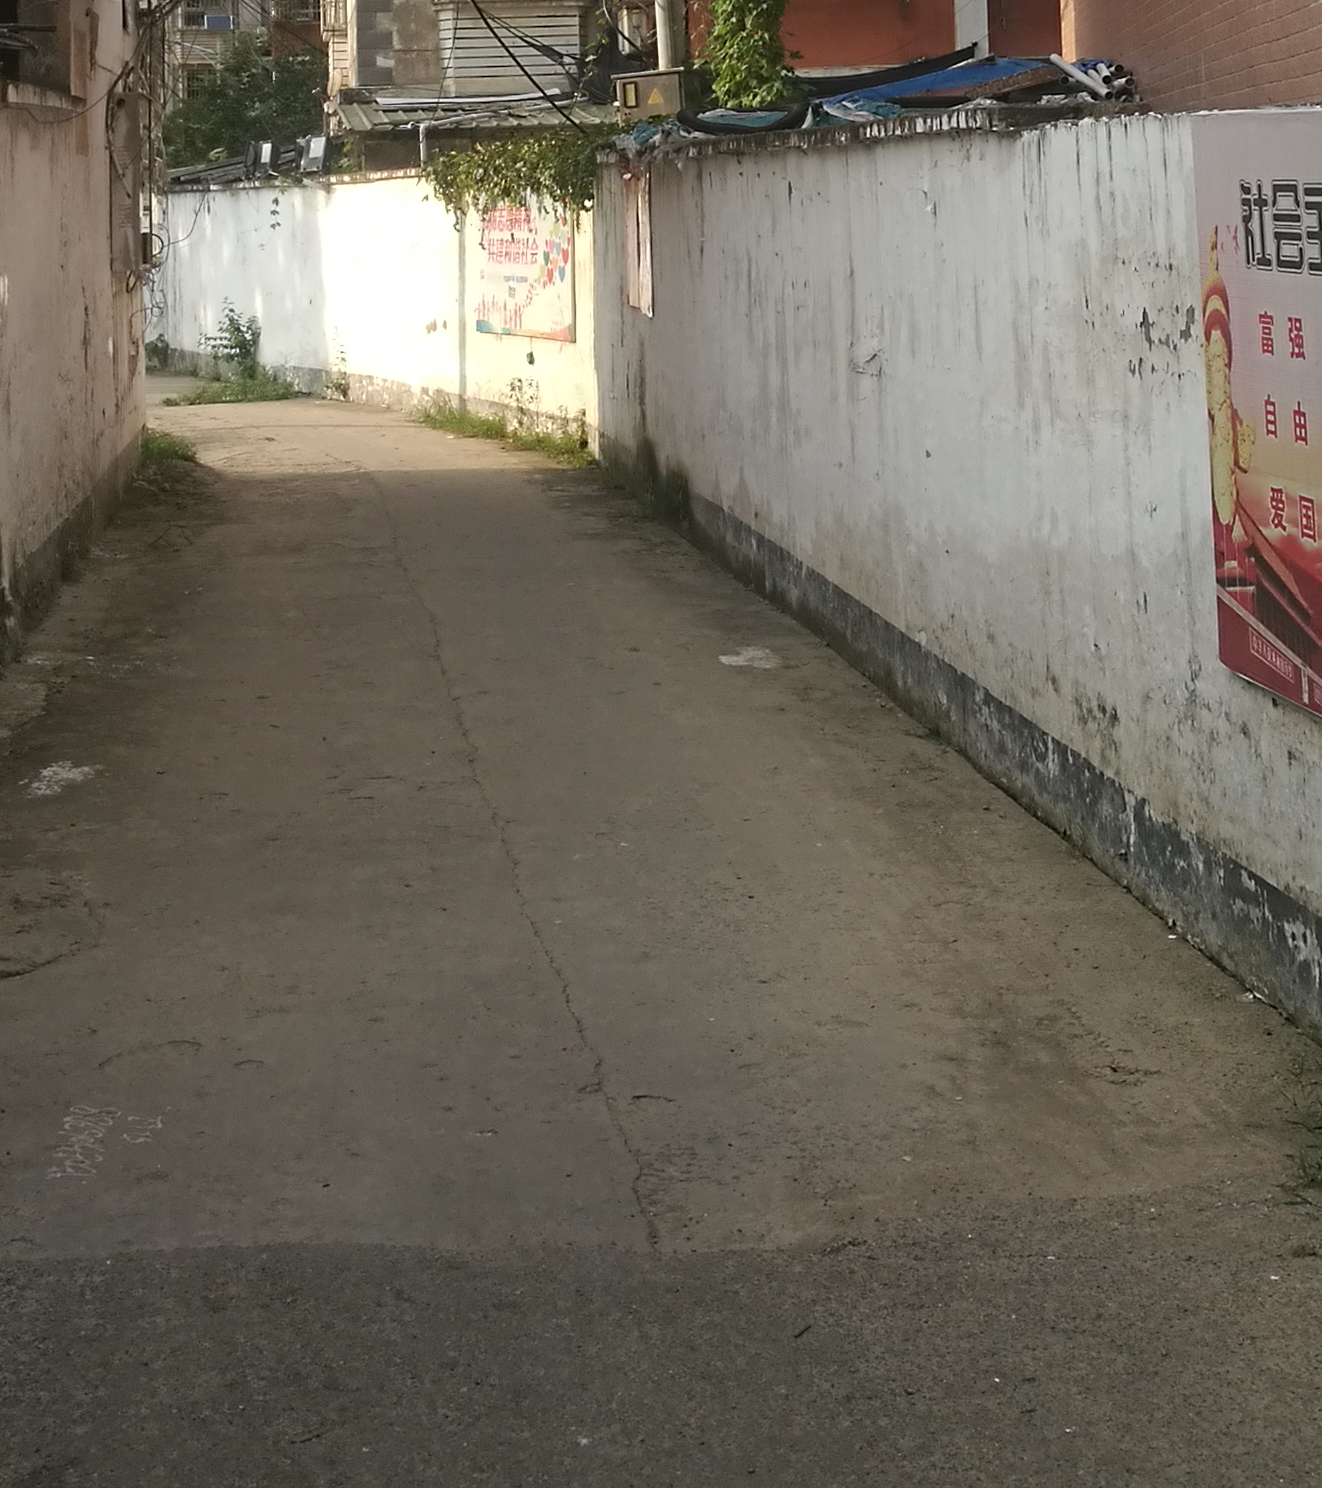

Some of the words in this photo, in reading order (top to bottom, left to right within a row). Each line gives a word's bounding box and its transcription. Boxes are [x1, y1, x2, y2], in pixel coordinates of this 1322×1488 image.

[1258, 312, 1306, 360] 富强
[1264, 394, 1309, 446] 自由
[1269, 487, 1317, 543] 爱国
